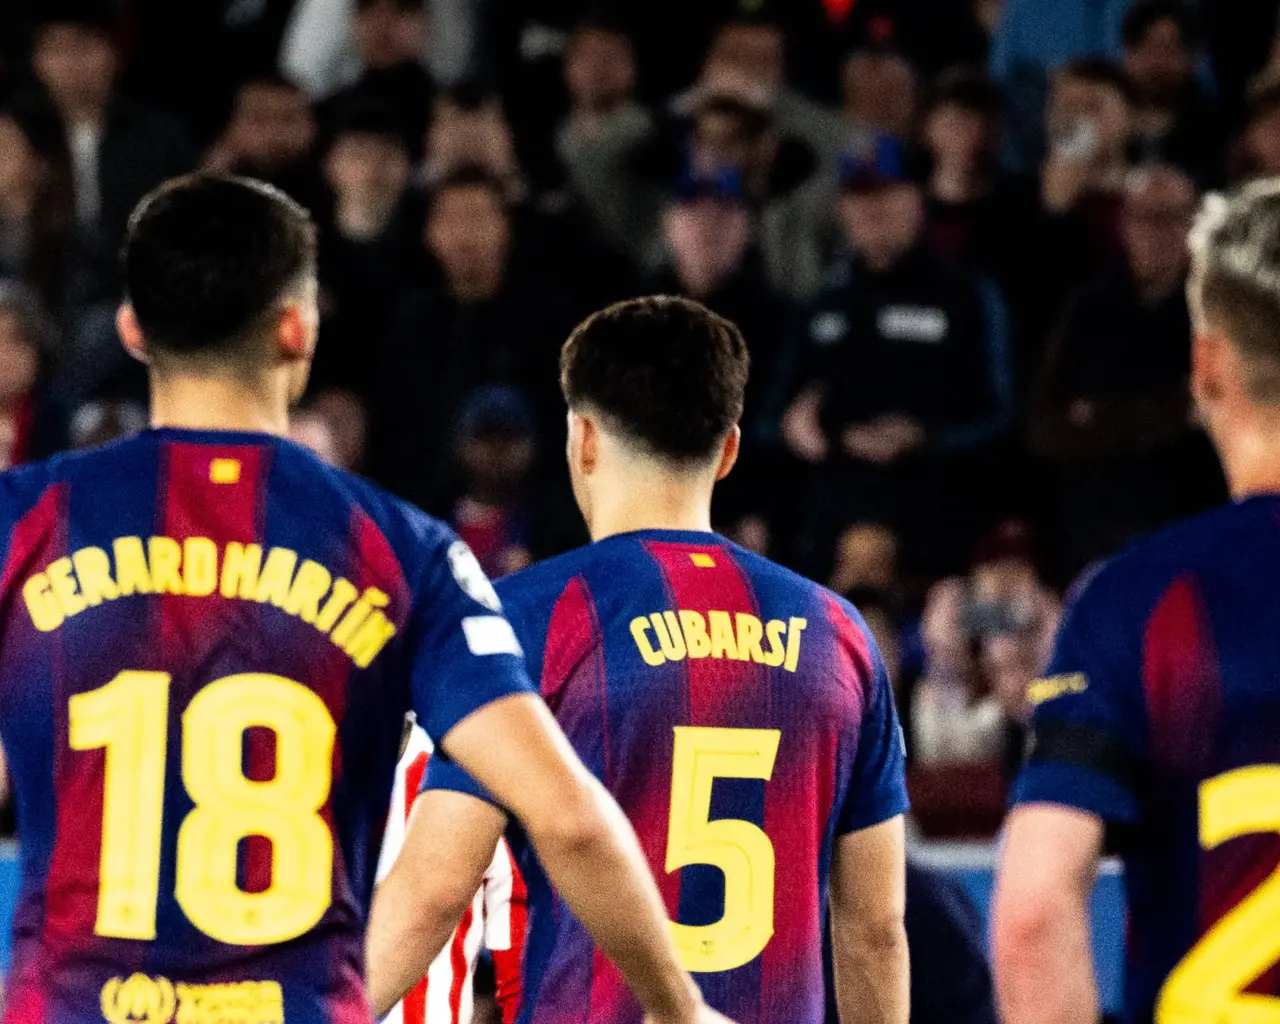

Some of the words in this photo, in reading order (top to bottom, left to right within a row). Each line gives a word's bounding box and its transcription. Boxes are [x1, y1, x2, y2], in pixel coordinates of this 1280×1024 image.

[23, 536, 218, 632] GERARD
[629, 609, 807, 673] CUBARSÍ
[68, 669, 337, 946] 18
[665, 726, 781, 973] 5
